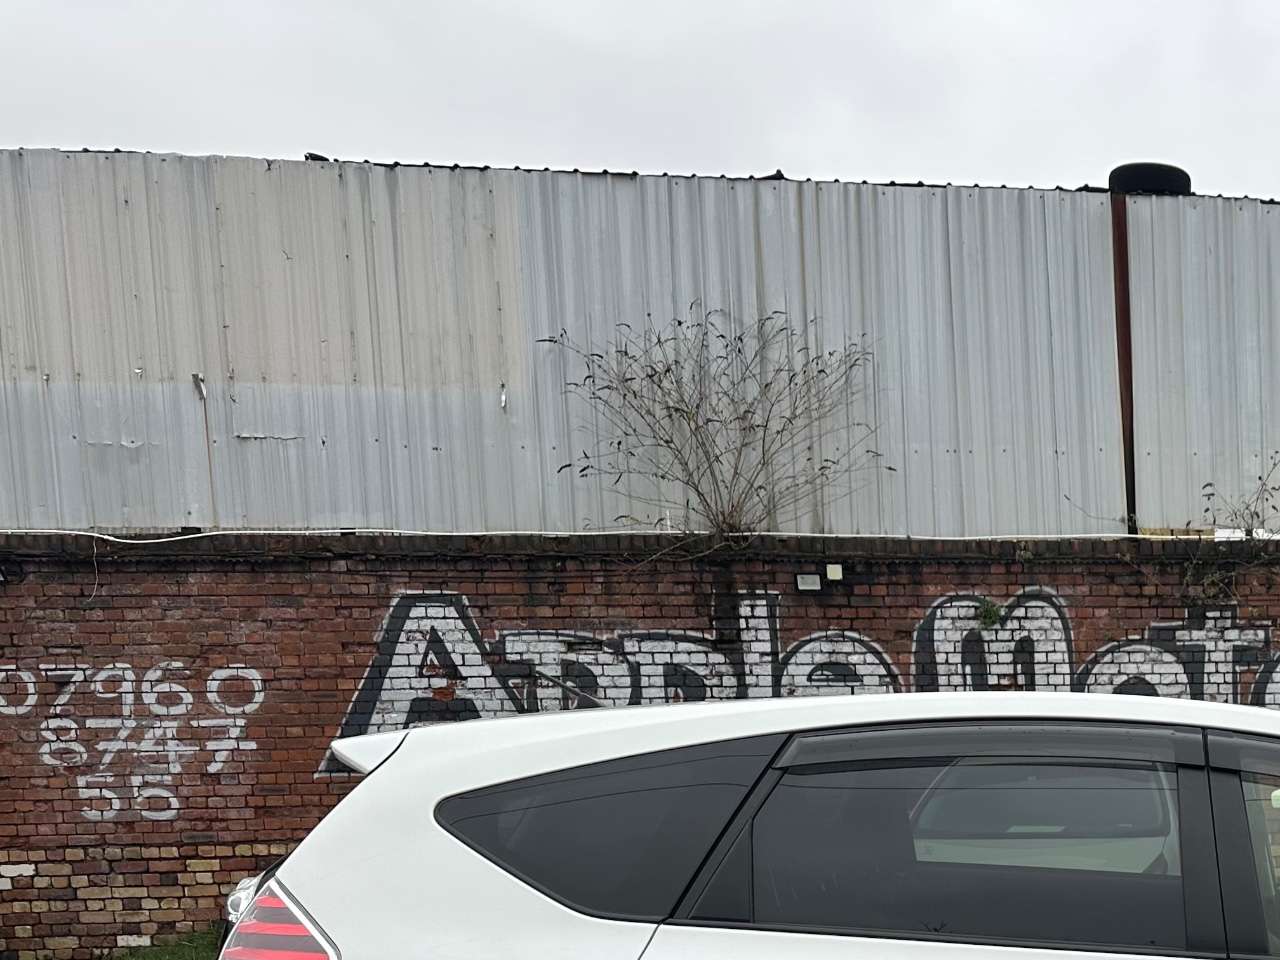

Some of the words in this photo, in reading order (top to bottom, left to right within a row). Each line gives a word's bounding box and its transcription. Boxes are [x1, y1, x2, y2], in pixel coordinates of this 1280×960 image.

[0, 661, 265, 716] 07960
[38, 717, 259, 774] 8747
[76, 772, 180, 821] 55
